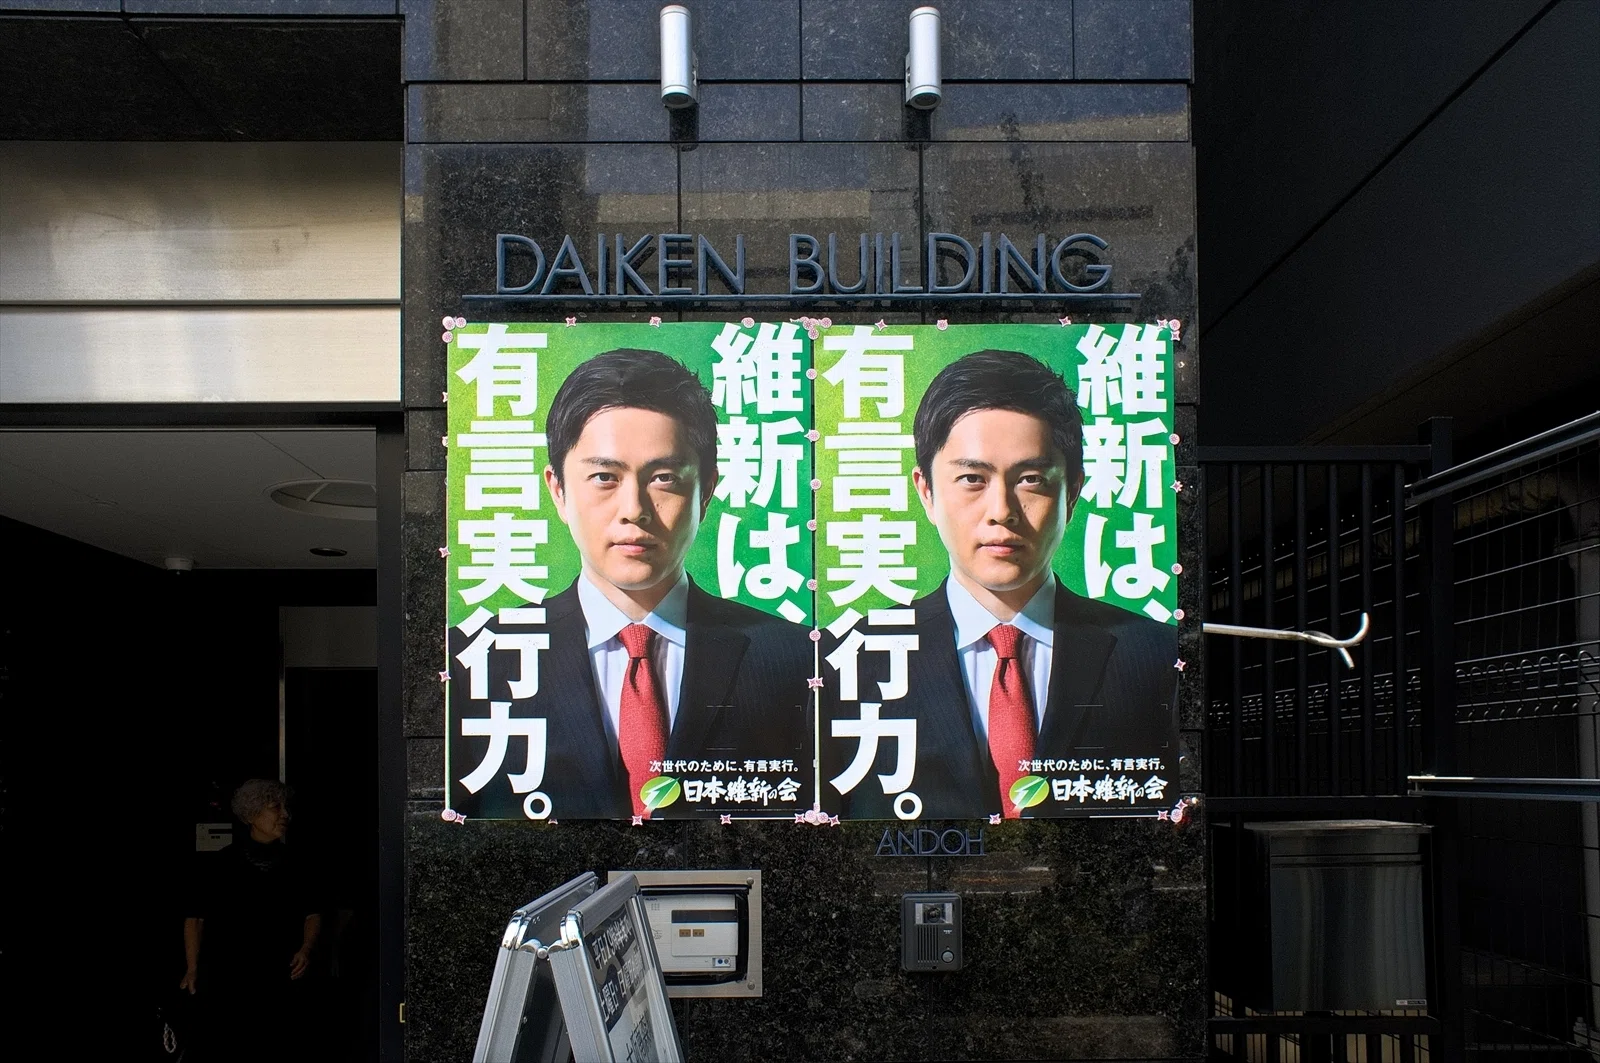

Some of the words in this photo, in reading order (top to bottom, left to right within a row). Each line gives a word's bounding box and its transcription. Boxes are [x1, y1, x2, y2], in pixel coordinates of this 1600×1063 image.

[496, 233, 744, 296] DAIKEN
[789, 232, 1113, 295] BUILDING
[710, 322, 808, 623] 維新は、
[1076, 323, 1173, 624] 維新は、
[454, 323, 553, 820] 有言実行力。
[822, 325, 923, 821] 有言実行力。
[649, 759, 799, 773] 次世代のために、有言実行。
[1018, 758, 1166, 772] 次世代のために、有言実行。
[683, 775, 802, 807] 日本維新の会
[1051, 774, 1169, 805] 日本維新の会
[876, 829, 985, 856] ANDOH
